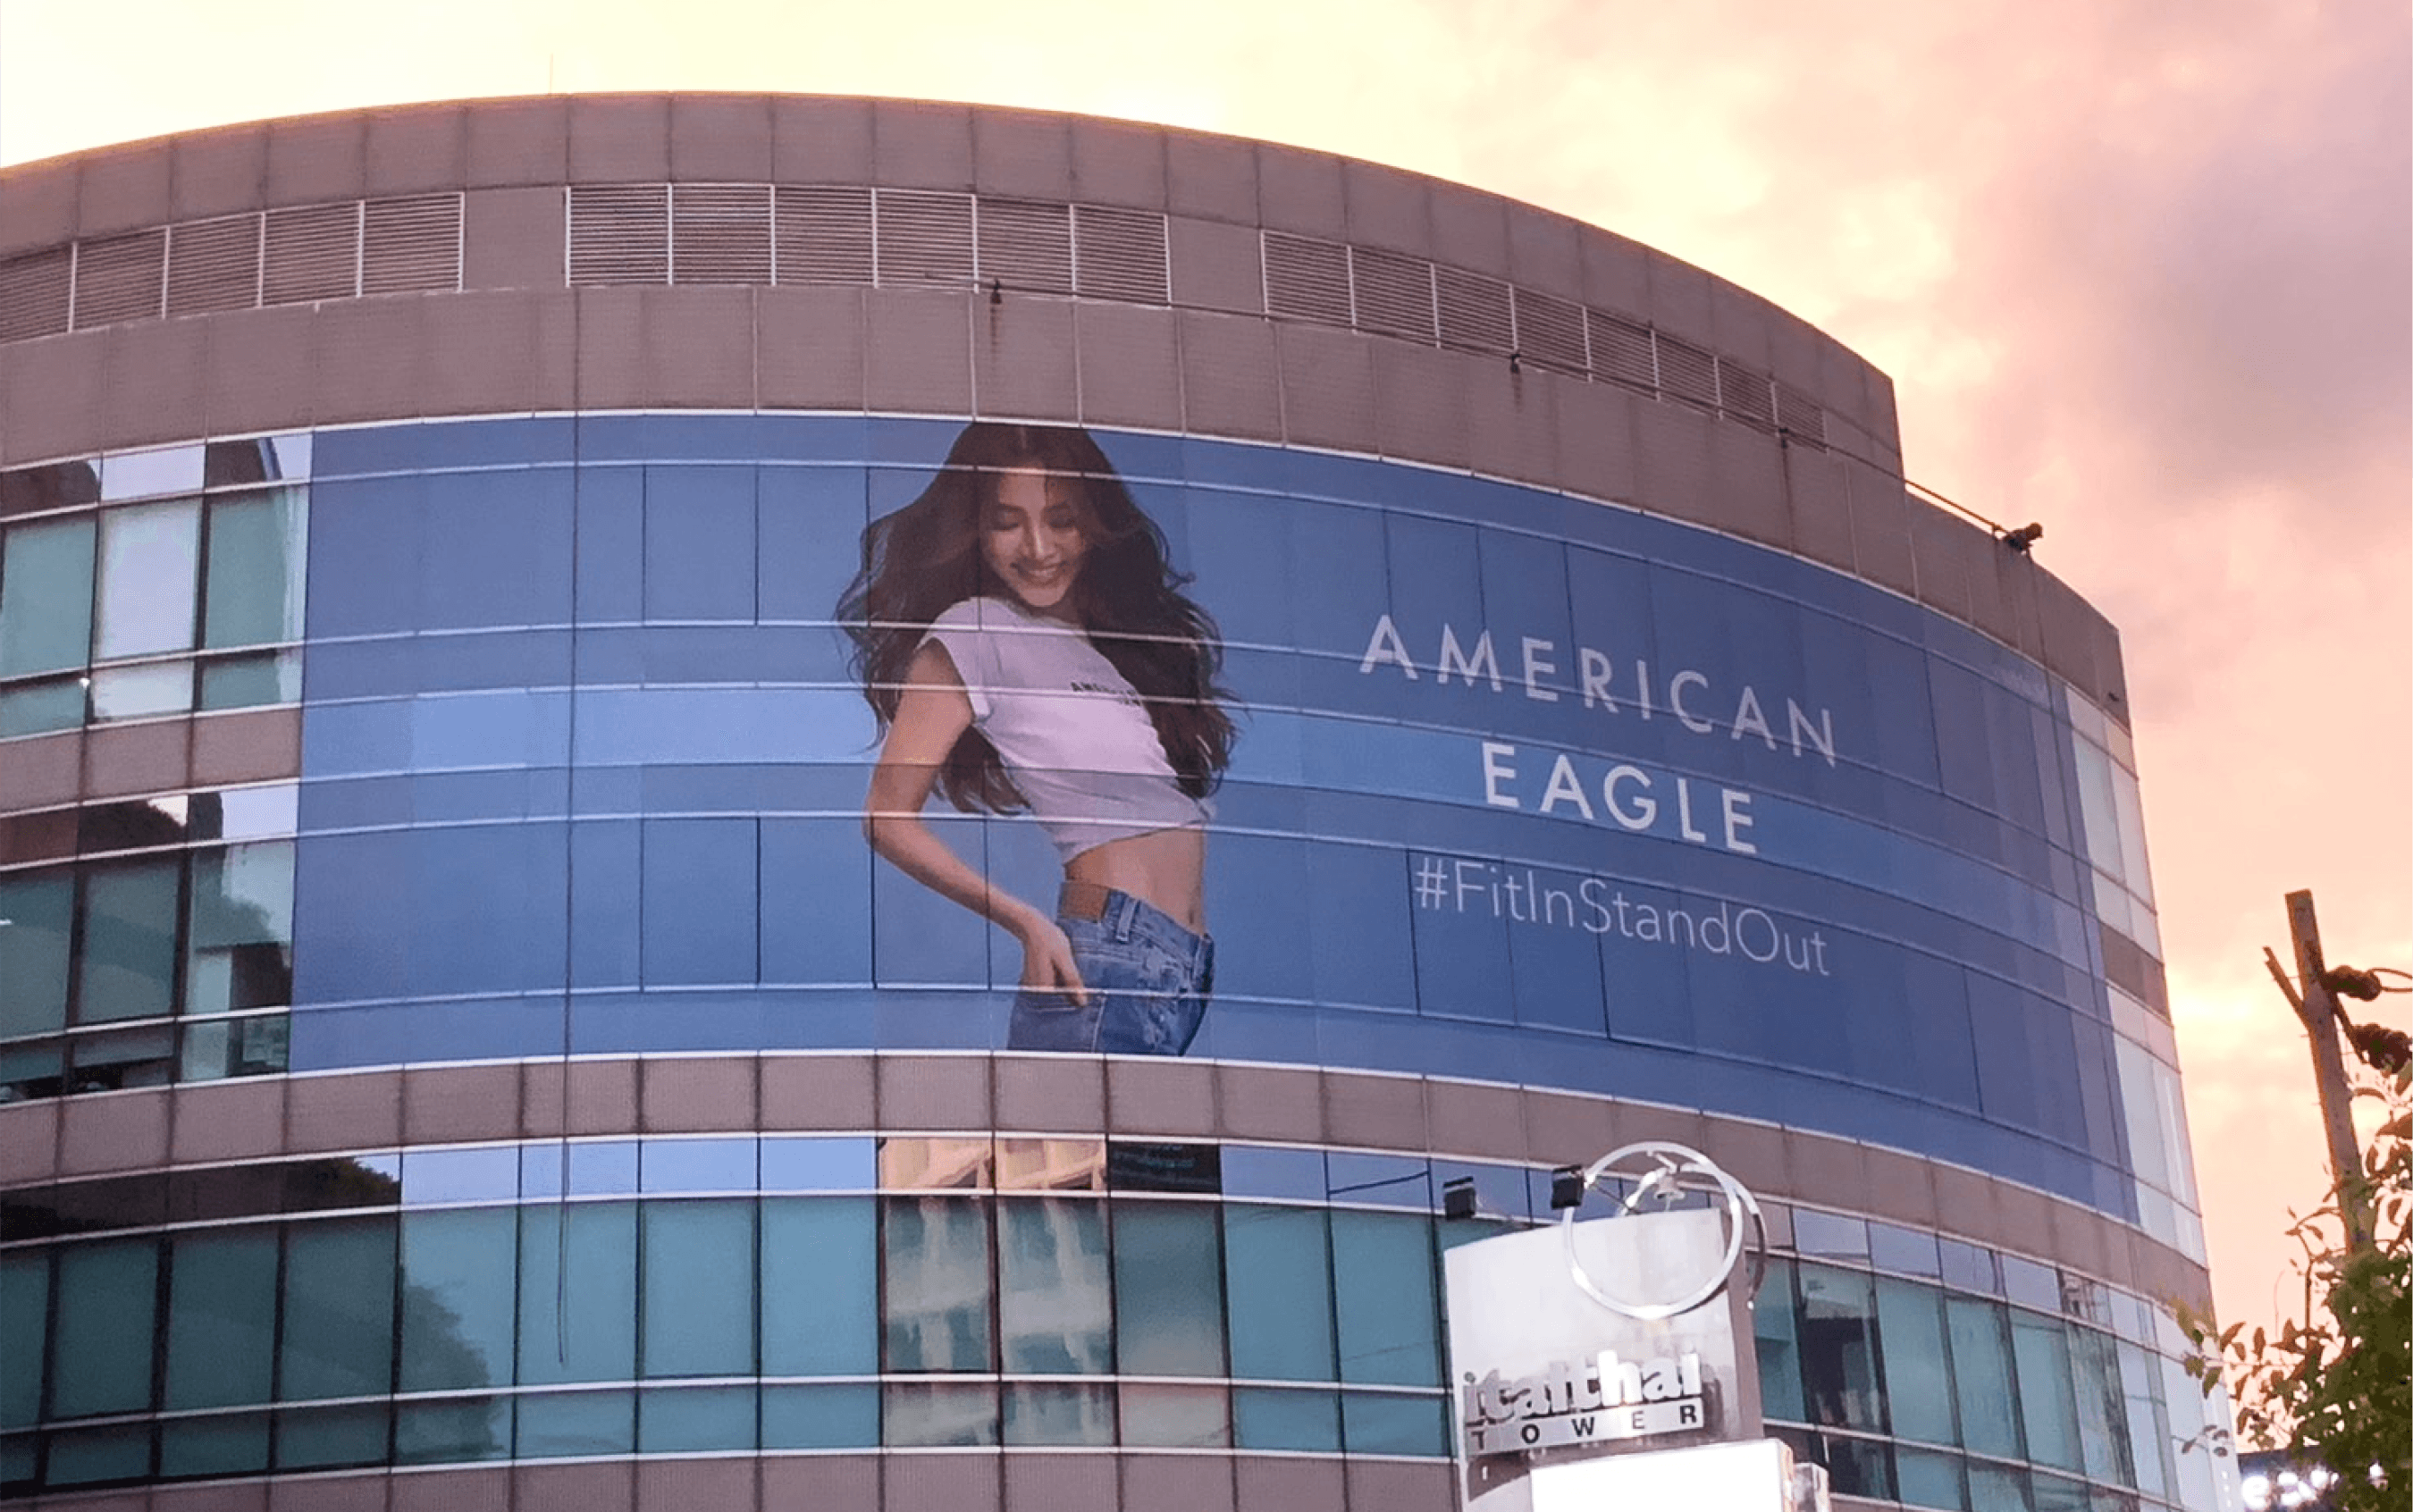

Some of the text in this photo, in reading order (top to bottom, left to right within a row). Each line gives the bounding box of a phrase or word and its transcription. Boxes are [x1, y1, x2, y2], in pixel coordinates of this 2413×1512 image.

[1359, 614, 1837, 768] AMERICAN
[1482, 741, 1758, 854] EAGLE
[1414, 855, 1830, 977] #FitInStandOut
[1463, 1348, 1702, 1427] italthai
[1470, 1404, 1698, 1450] TOWER
